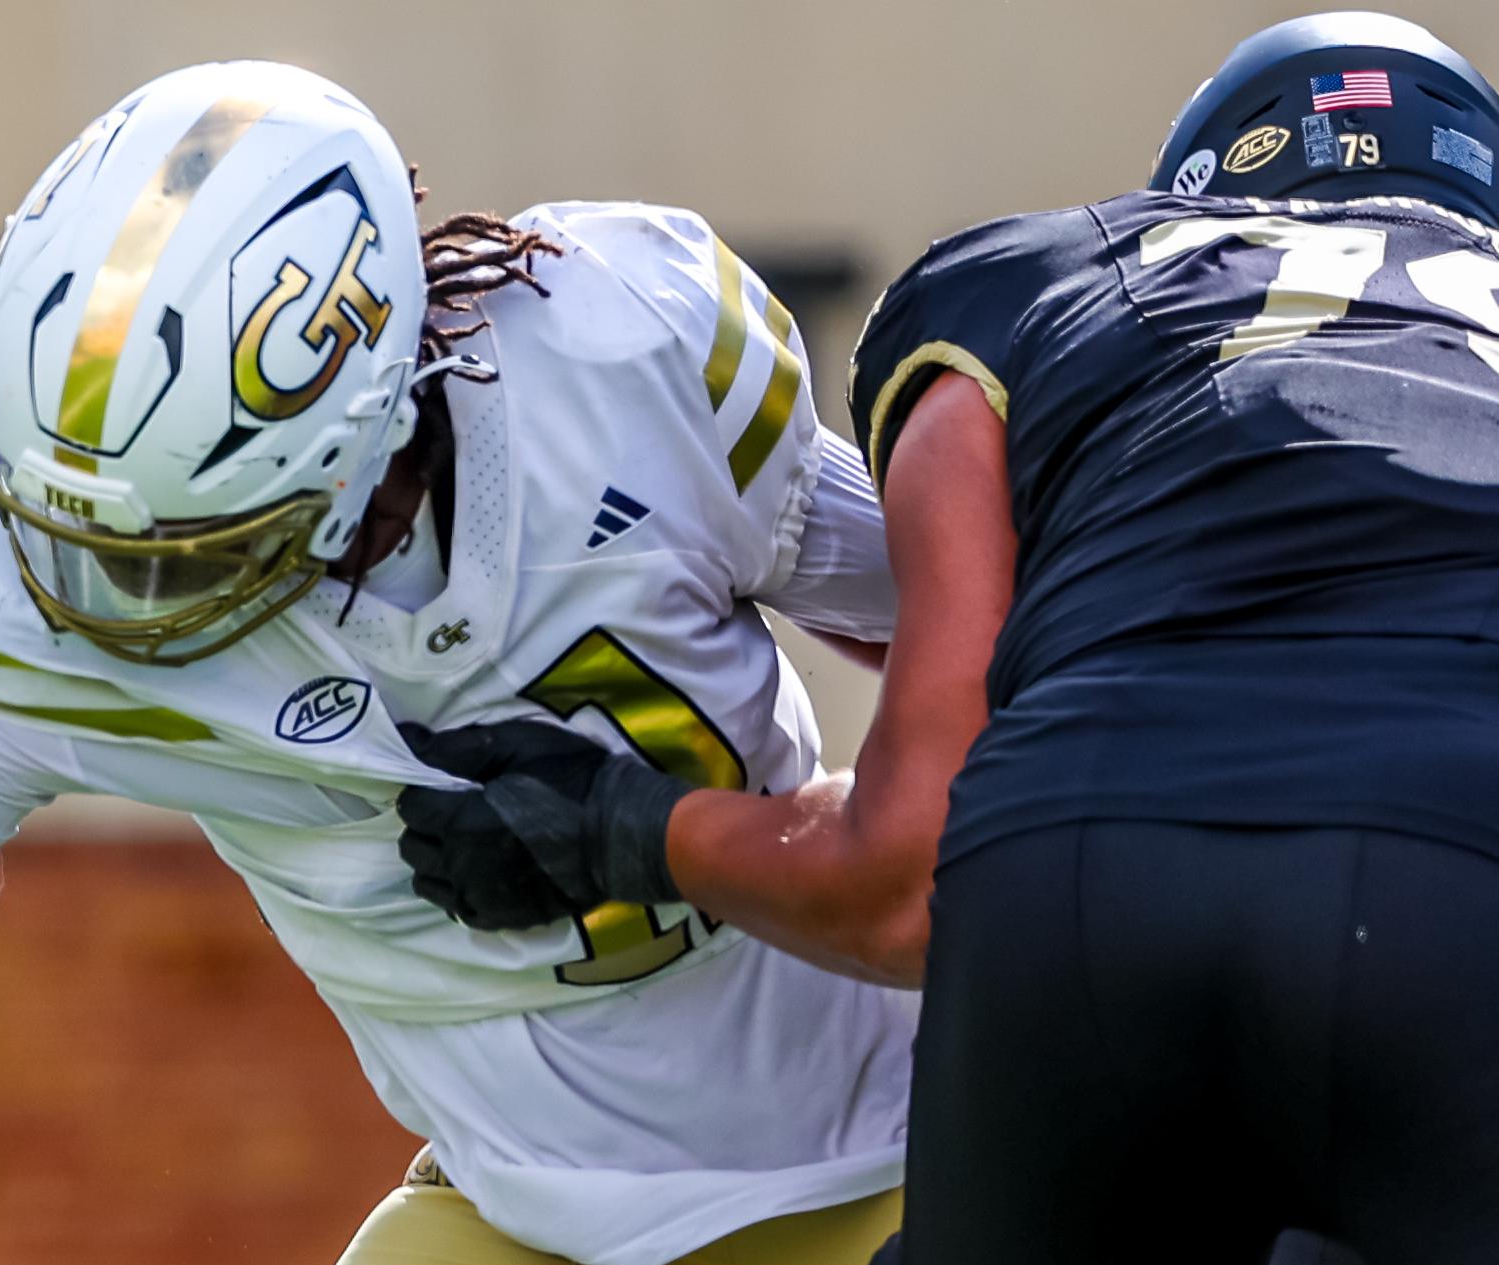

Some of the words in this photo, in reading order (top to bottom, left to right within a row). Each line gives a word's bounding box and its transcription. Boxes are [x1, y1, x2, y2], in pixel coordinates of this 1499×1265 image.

[1231, 130, 1278, 165] ACC
[1338, 133, 1380, 167] 79
[234, 214, 393, 422] GT
[427, 617, 471, 653] GT
[292, 680, 357, 732] ACC
[516, 625, 771, 986] 1
